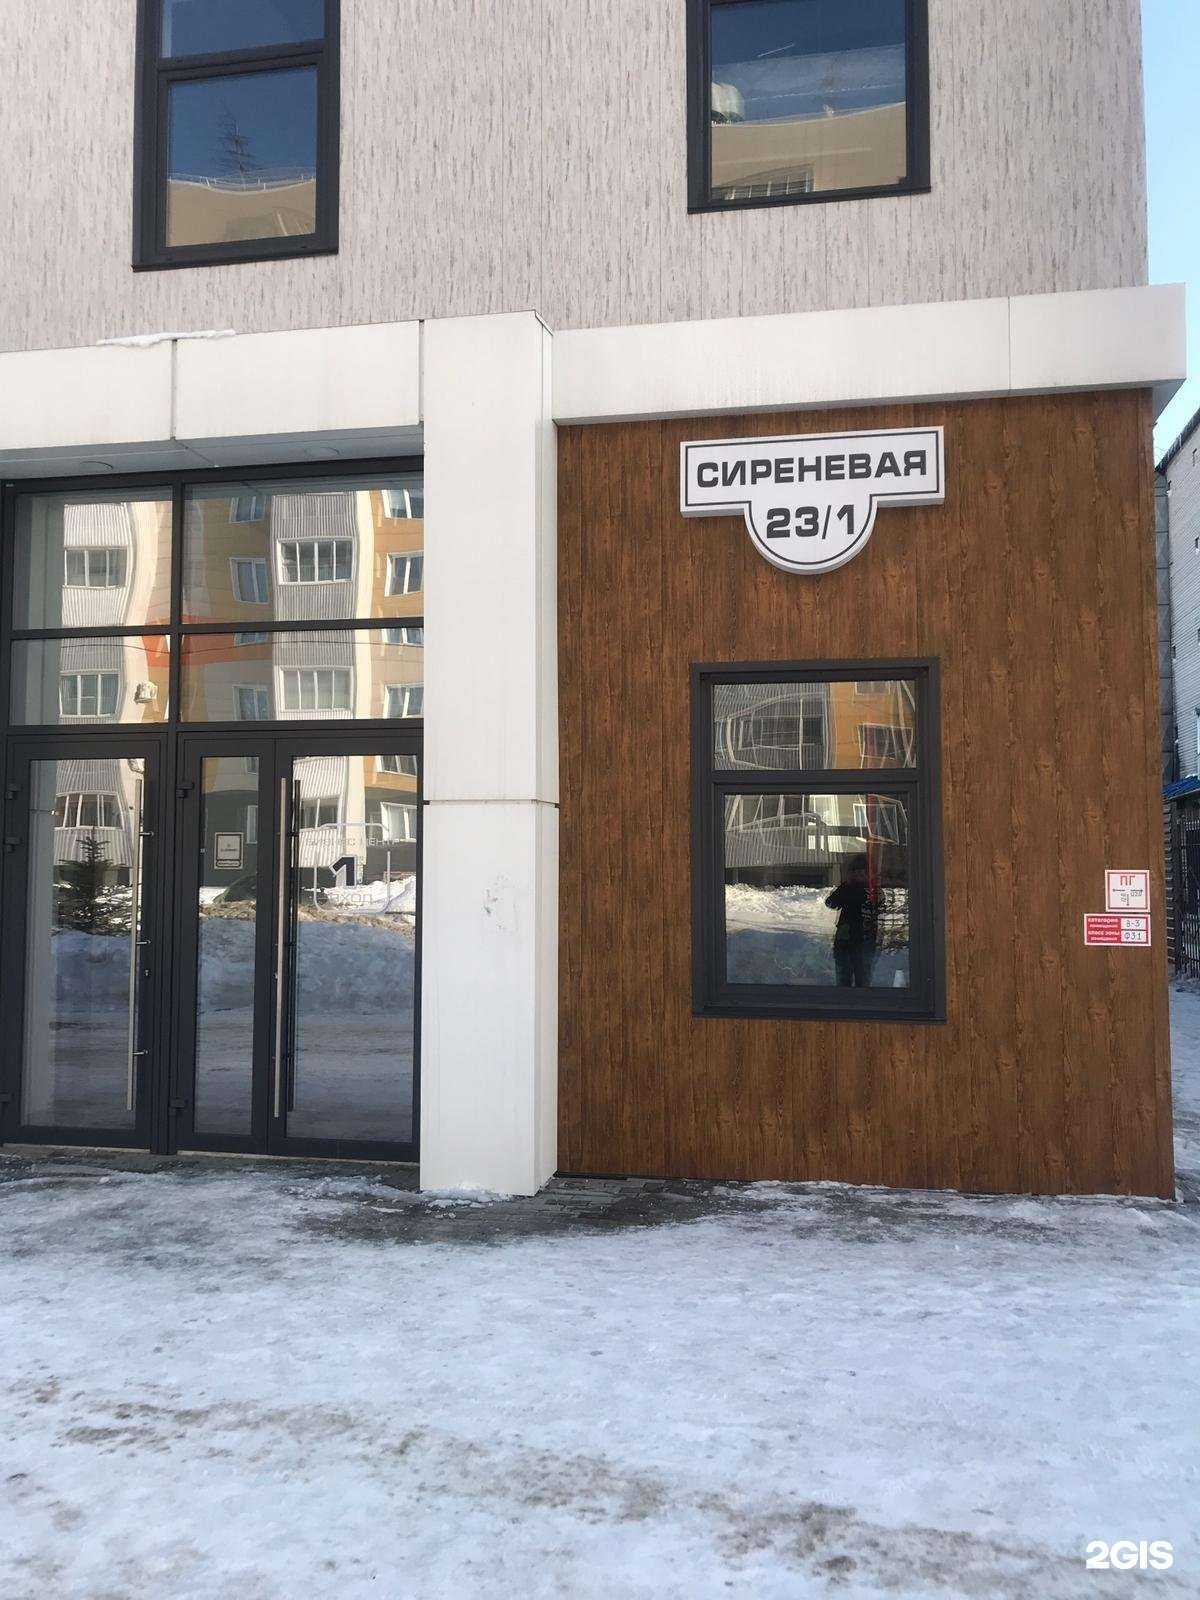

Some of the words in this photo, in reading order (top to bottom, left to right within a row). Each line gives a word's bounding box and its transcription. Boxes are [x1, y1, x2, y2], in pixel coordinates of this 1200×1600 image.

[697, 450, 927, 488] СИРЕНЕВАЯ
[766, 504, 855, 540] 23/1
[1120, 874, 1135, 886] ПГ
